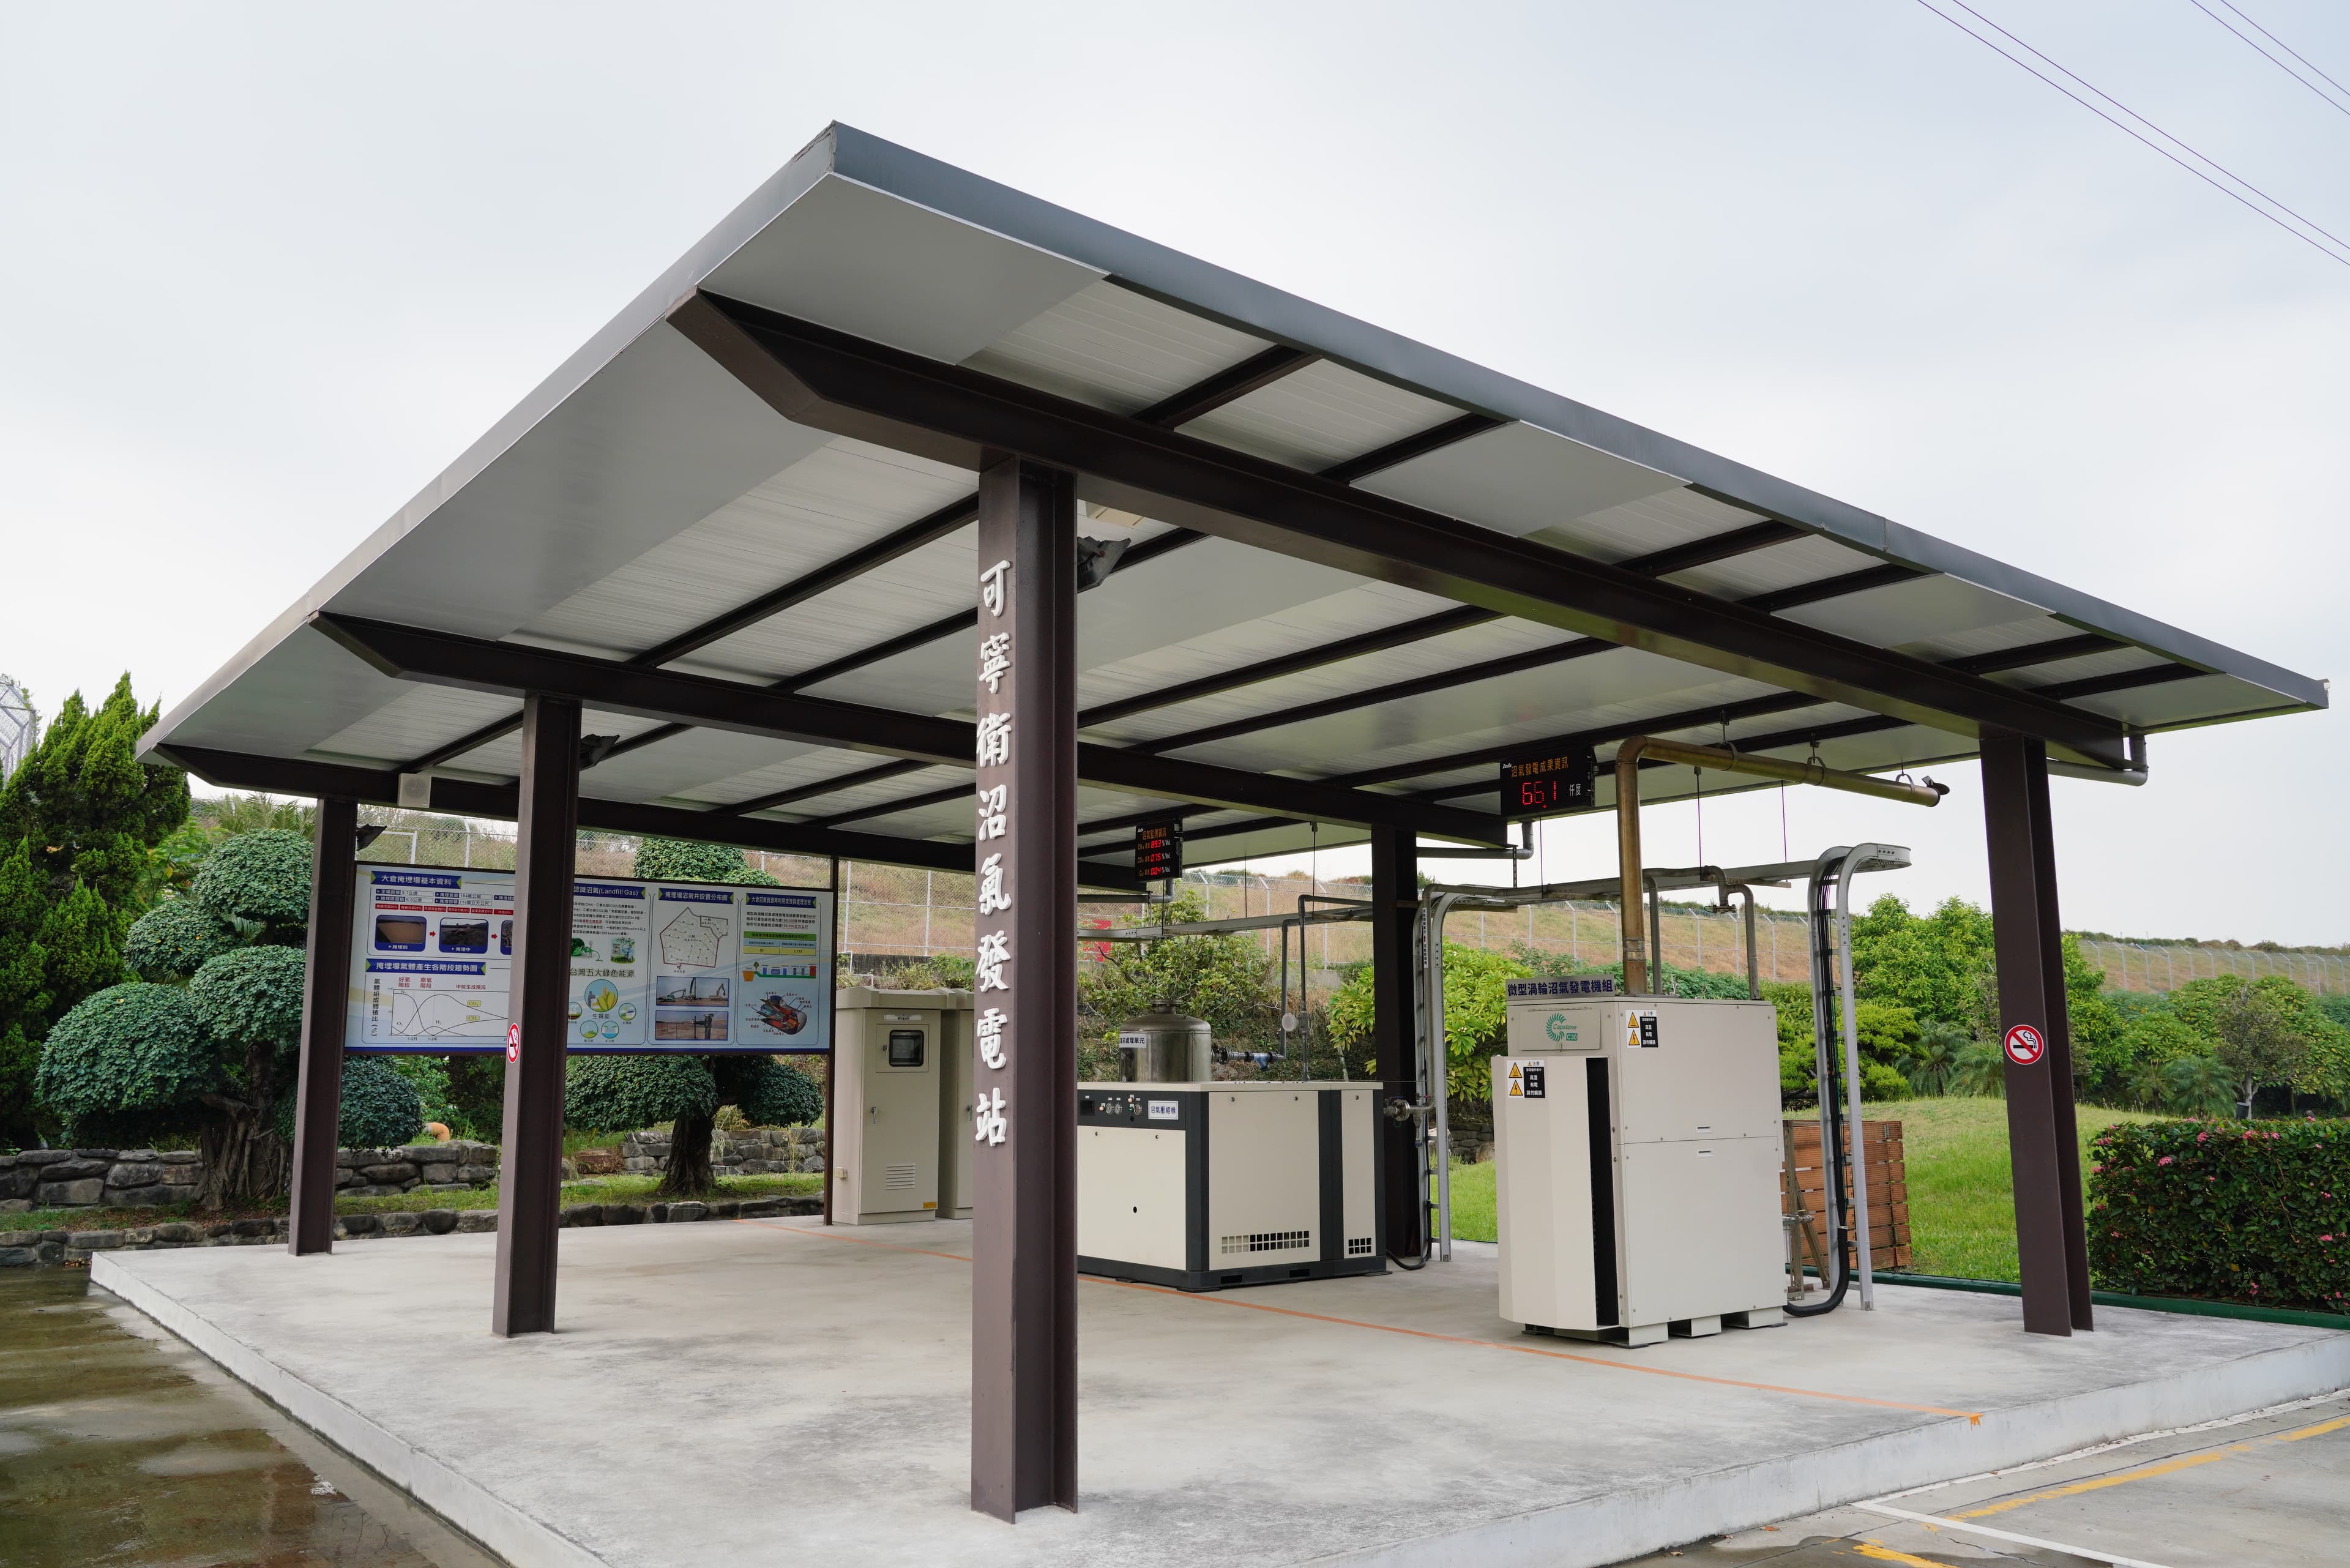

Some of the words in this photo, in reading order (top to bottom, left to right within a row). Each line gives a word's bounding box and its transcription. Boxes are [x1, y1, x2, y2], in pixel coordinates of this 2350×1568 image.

[1511, 756, 1569, 778] 沼氣發電成果資訊
[1569, 783, 1581, 797] 仟度
[976, 559, 1012, 1147] 可寧衛沼氣發電站
[381, 875, 452, 886] 大倉掩埋場基本資料
[665, 892, 728, 901] 掩埋場沼氣井設置分布圖
[376, 962, 477, 973] 掩埋場氣體產生各階段趨勢圖
[570, 968, 635, 978] 台灣五大綠色能源
[1507, 979, 1613, 996] 微型渦輪沼氣發電機組
[1150, 1106, 1176, 1114] 沼氣壓縮機
